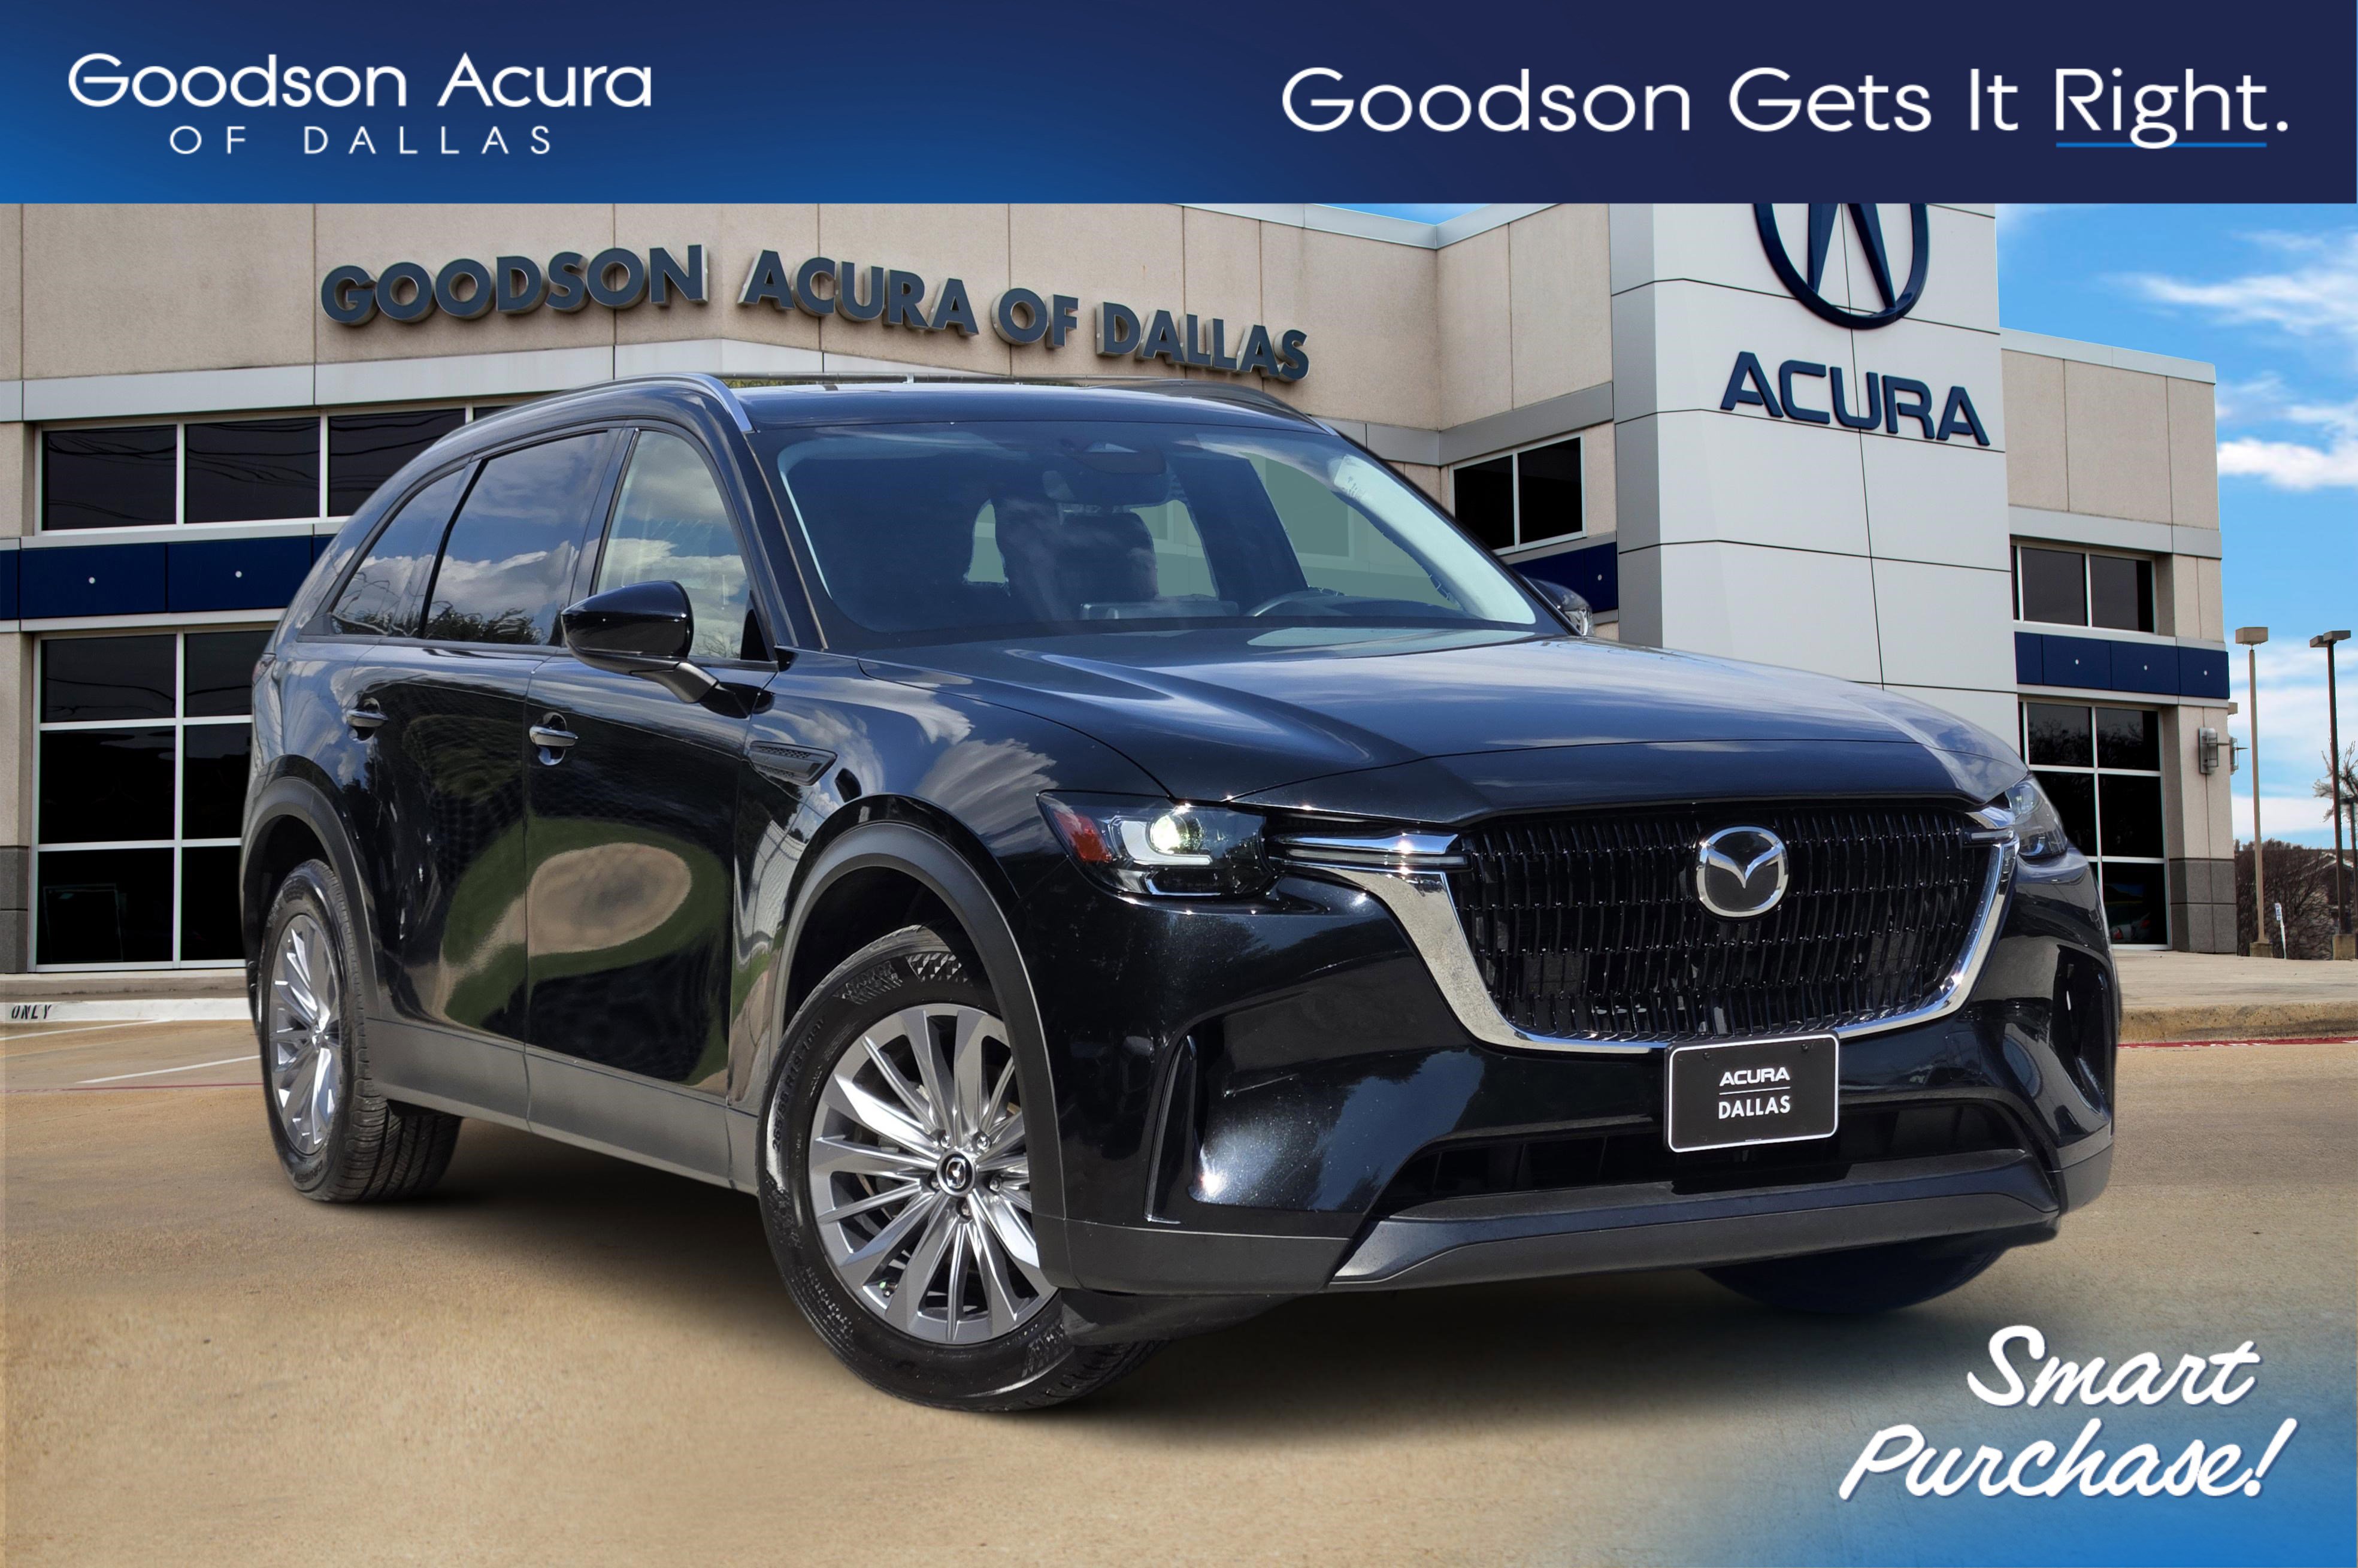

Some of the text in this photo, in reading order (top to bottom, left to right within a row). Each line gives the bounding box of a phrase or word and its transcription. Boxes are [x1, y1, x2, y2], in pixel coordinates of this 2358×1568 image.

[320, 244, 1310, 382] GOODSON ACURA OF DALLAS
[1720, 350, 1990, 446] ACURA
[11, 1004, 52, 1019] ONLY
[1719, 1066, 1790, 1087] ACURA
[1718, 1095, 1790, 1120] DALLAS
